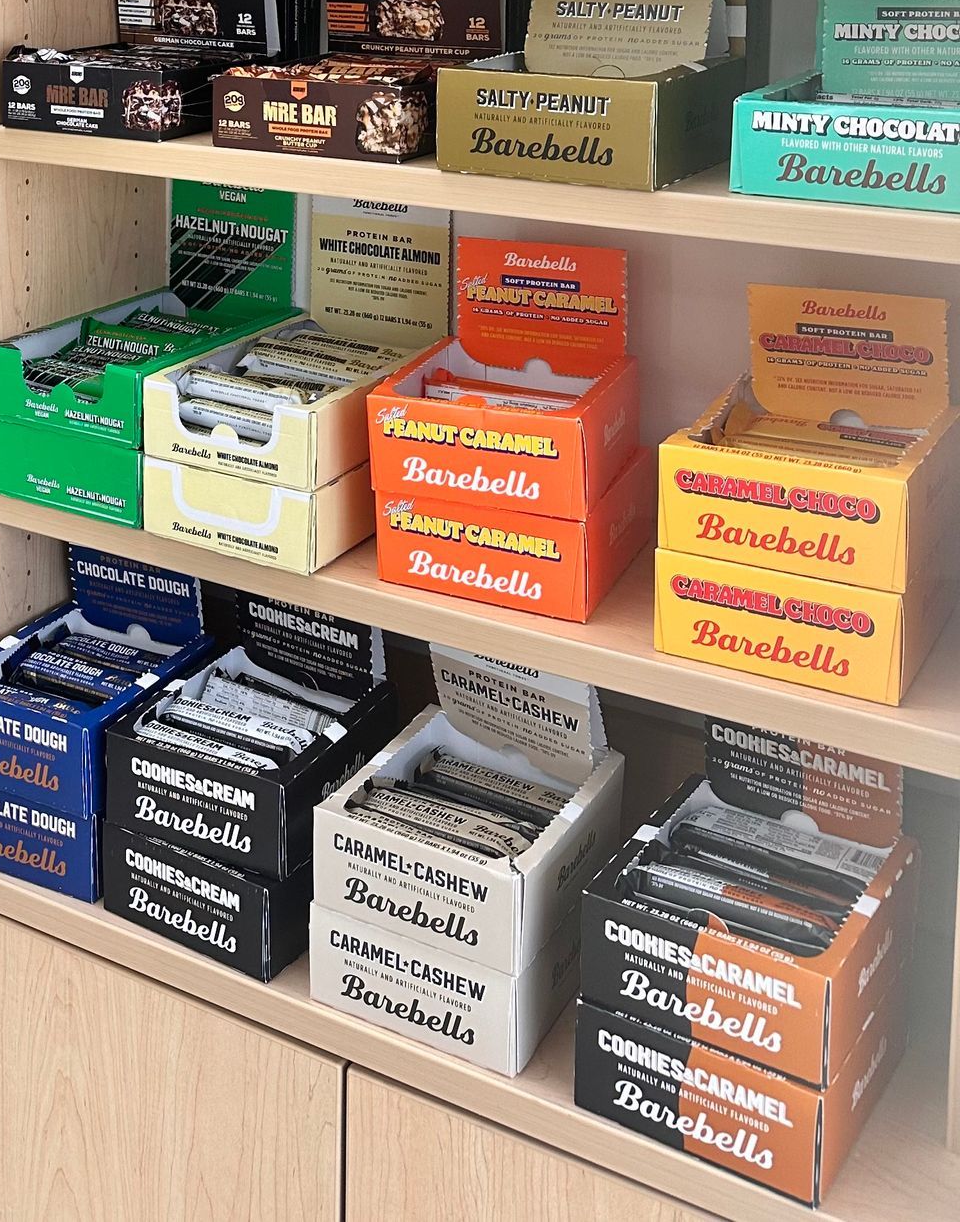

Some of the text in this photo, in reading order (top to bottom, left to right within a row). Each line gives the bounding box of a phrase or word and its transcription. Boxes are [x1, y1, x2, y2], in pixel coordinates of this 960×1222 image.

[236, 28, 257, 36] BARS
[237, 13, 252, 24] 12
[466, 33, 490, 41] BARS
[469, 18, 486, 28] 12
[833, 23, 901, 42] MINTY
[180, 39, 216, 47] CHOCOLATE
[263, 100, 338, 127] MRE BAR
[469, 127, 613, 166] Barebells
[782, 139, 944, 158] FLAVORED WITH OTHER NATURAL FLAVORS
[777, 153, 947, 194] Barebells
[219, 190, 247, 202] VEGAN
[320, 237, 440, 265] WHITE CHOCOLATE ALMOND
[346, 230, 412, 244] PROTEIN BAR
[504, 253, 576, 272] Barebells
[467, 285, 618, 315] PEANUT CARAMEL
[802, 300, 887, 321] Barebells
[759, 333, 934, 364] CARAMEL CHOCO
[172, 443, 211, 460] Barebells
[382, 417, 558, 460] PEANUT CARAMEL
[401, 455, 541, 502] Barebells
[674, 469, 880, 523] CARAMEL CHOCO
[172, 522, 211, 539] Barebells
[390, 511, 560, 560] PEANUT CARAMEL
[697, 513, 856, 567] Barebells
[76, 559, 190, 599] CHOCOLATE DOUGH
[408, 550, 543, 601] Barebells
[670, 574, 874, 636] CARAMEL CHOCO
[692, 619, 850, 678] Barebells
[469, 670, 545, 703] PROTEIN BAR
[24, 725, 67, 754] DOUGH
[131, 756, 255, 811] COOKIES&CREAM
[137, 781, 247, 822] NATURALLY AND ARTIFICIALLY FLAVORED
[31, 809, 76, 840] DOUGH
[135, 795, 252, 854] Barebells
[125, 849, 240, 914] COOKIES&CREAM
[347, 862, 475, 914] NATURALLY AND ARTIFICIALLY FLAVORED
[128, 887, 237, 954] Barebells
[344, 876, 480, 949] Barebells
[604, 918, 802, 1010] COOKIES&CARAMEL
[624, 951, 778, 1016] NATURALLY AND ARTIFICIALLY FLAVORED
[341, 974, 476, 1047] Barebells
[620, 970, 782, 1054] Barebells
[597, 1027, 794, 1129] COOKIES&CARAMEL
[613, 1079, 773, 1171] Barebells
